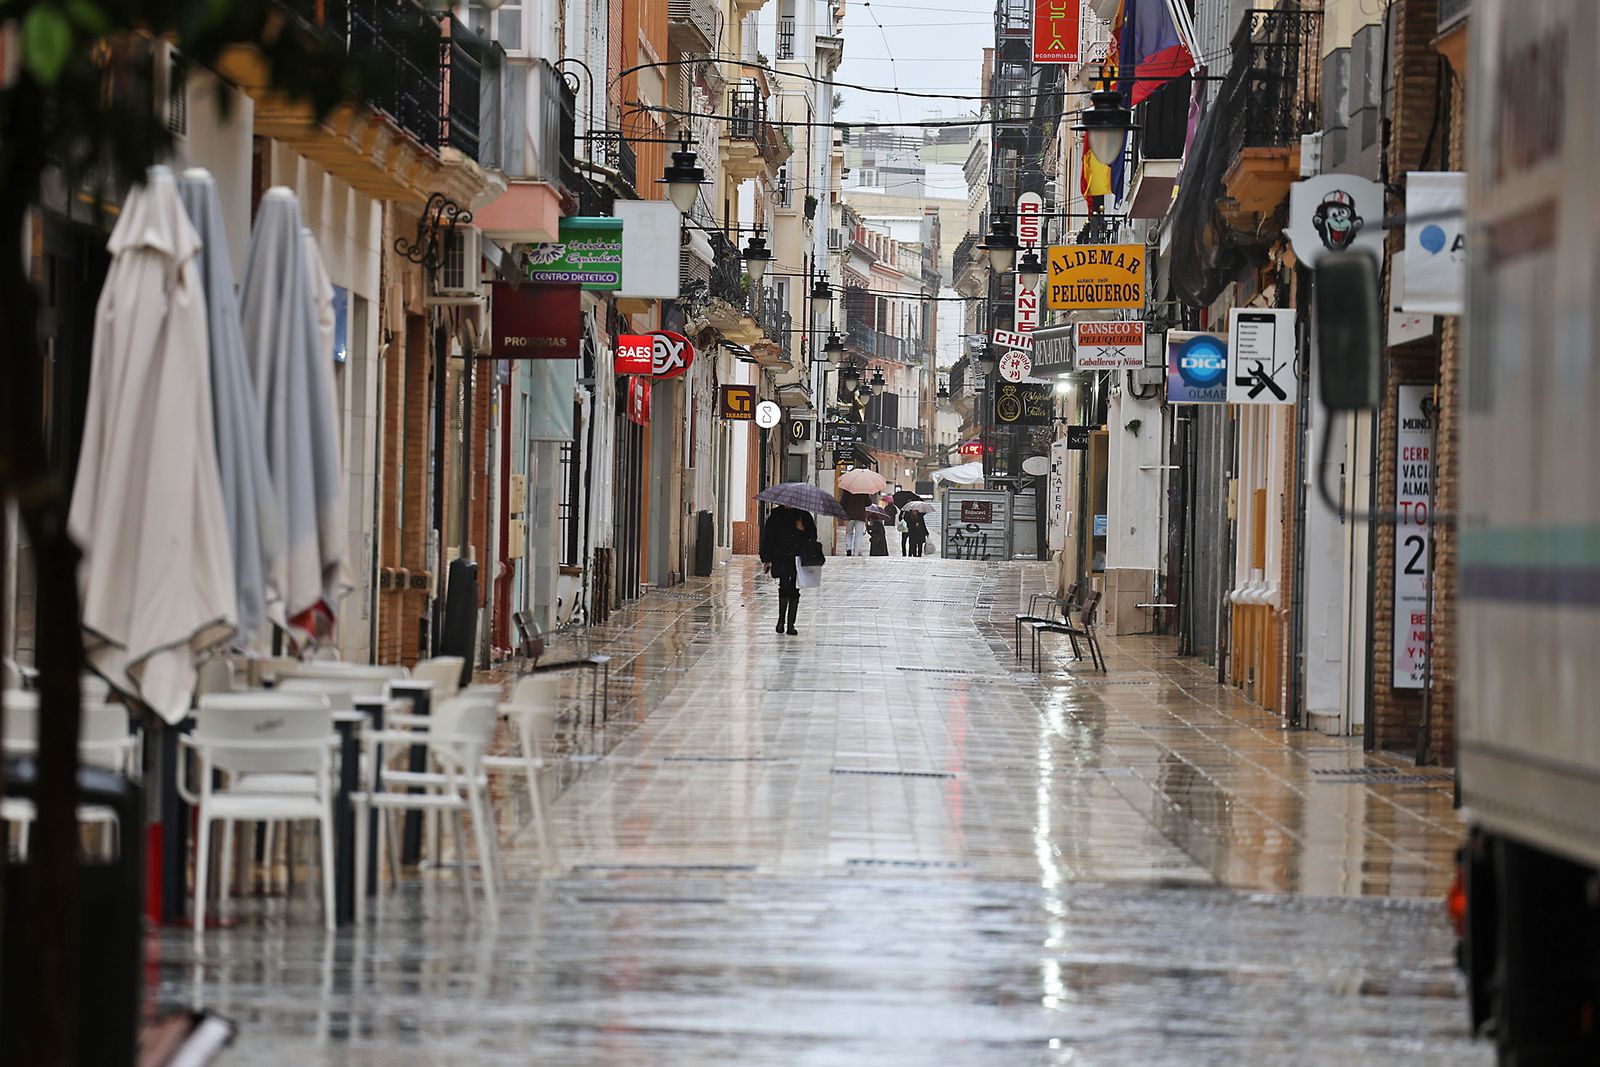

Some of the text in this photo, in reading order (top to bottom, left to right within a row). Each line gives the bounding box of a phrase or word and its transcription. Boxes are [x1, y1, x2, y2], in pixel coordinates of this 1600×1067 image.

[1018, 203, 1039, 332] RESTANTE
[1052, 249, 1141, 276] ALDEMAR
[535, 273, 614, 282] CENTRO DIETETICO
[1052, 284, 1140, 303] PELUQUEROS
[617, 346, 651, 358] GAES
[1034, 336, 1071, 366] BENAVENTE
[1013, 352, 1031, 371] DIVINO
[1079, 358, 1116, 366] Caballeros
[1123, 358, 1143, 366] Niños
[1181, 358, 1227, 369] DIGI
